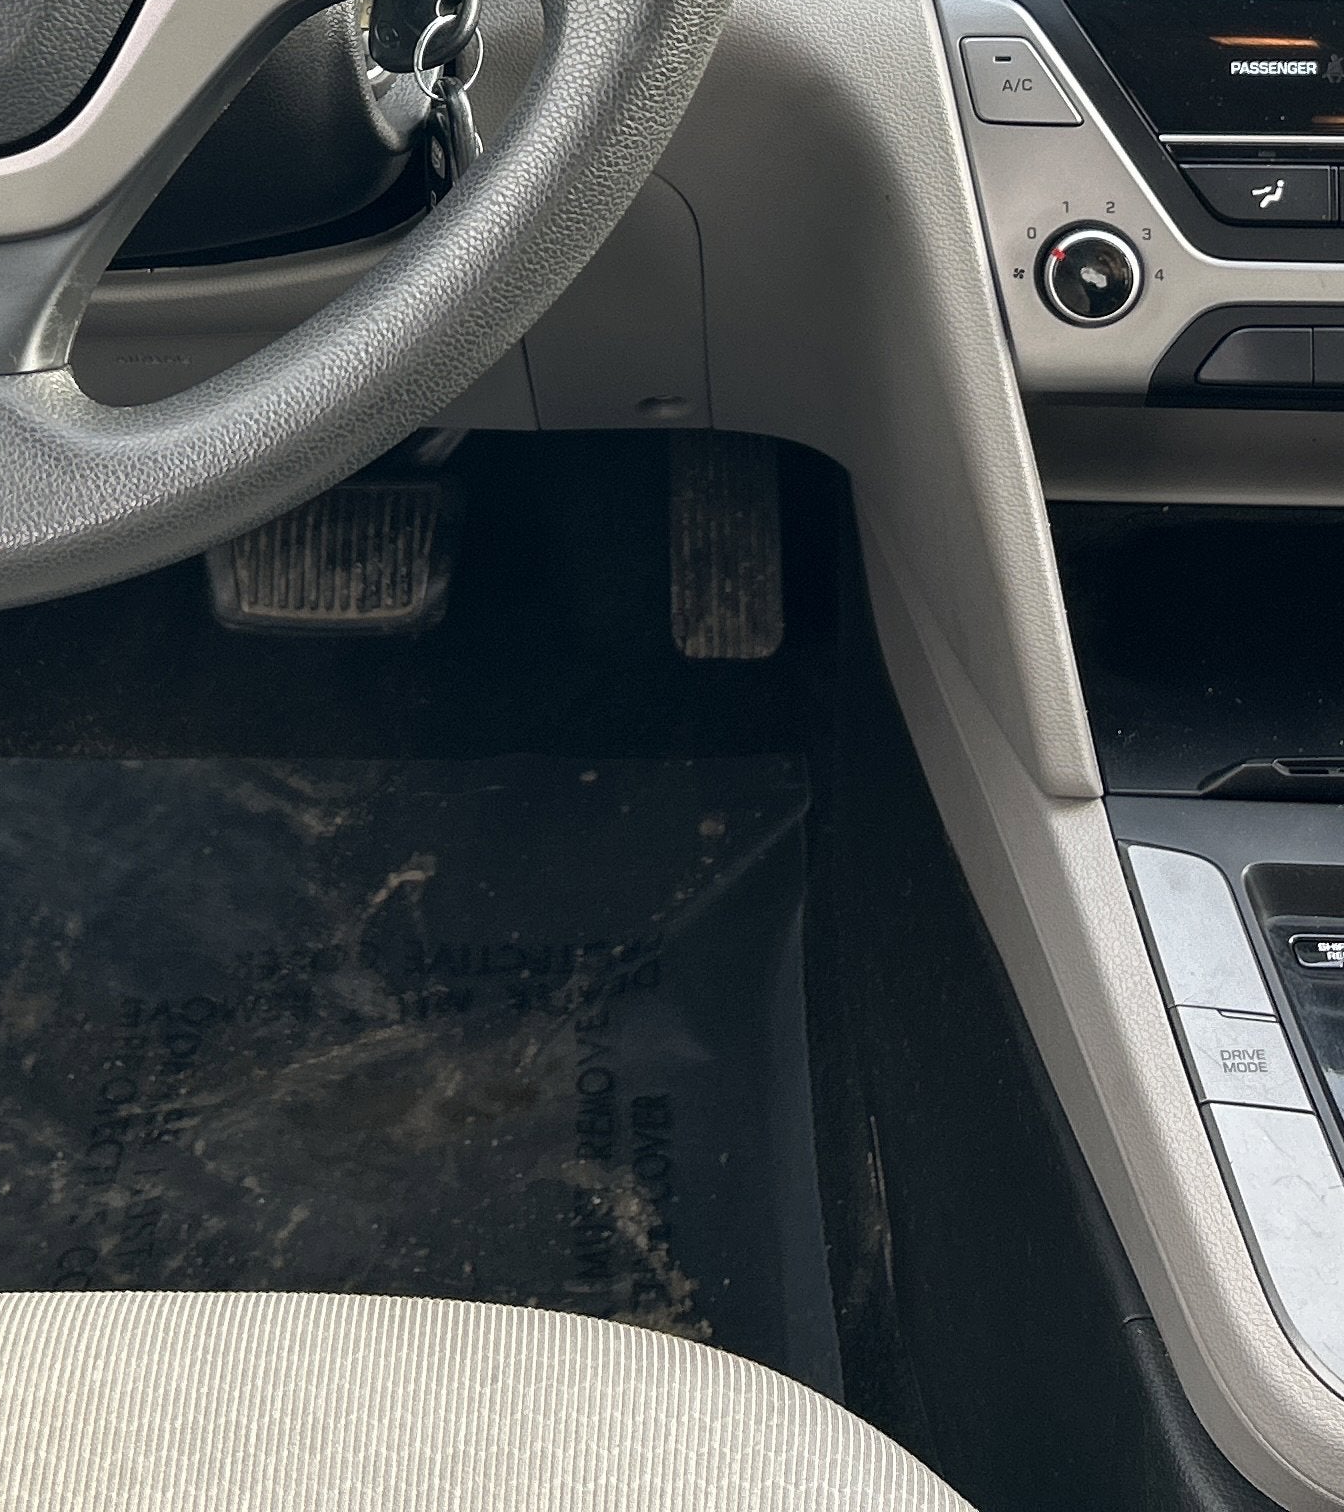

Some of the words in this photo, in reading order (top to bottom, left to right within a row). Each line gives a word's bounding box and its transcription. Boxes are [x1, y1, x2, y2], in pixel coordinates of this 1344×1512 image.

[1230, 60, 1318, 75] PASSENGER
[1001, 78, 1033, 93] A/C
[1062, 200, 1070, 214] 1
[1105, 200, 1116, 214] 2
[1141, 227, 1152, 241] 3
[1154, 268, 1165, 282] 4
[1219, 1048, 1267, 1062] DRIVE
[1222, 1061, 1269, 1074] MODE
